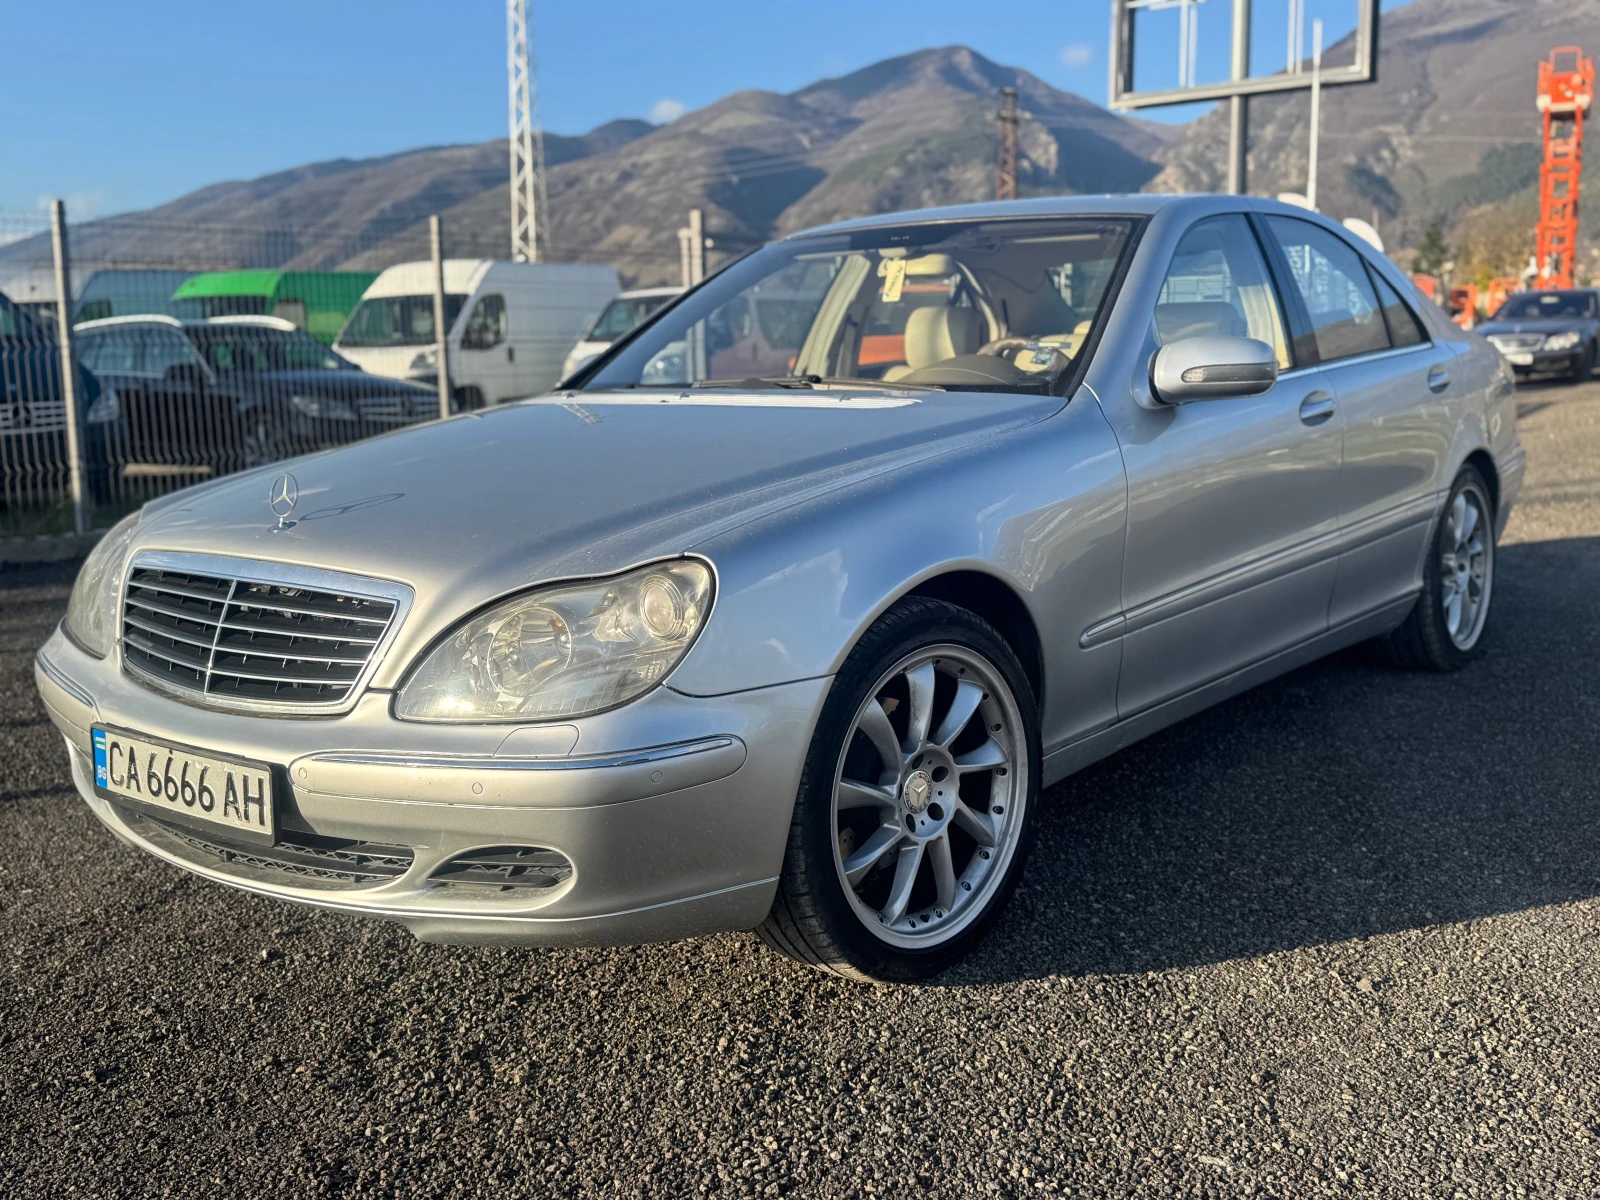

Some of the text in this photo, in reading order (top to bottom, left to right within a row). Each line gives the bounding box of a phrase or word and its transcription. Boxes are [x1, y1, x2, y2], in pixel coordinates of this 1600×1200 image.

[97, 765, 107, 780] BG
[109, 741, 266, 826] CA 6666 AH
